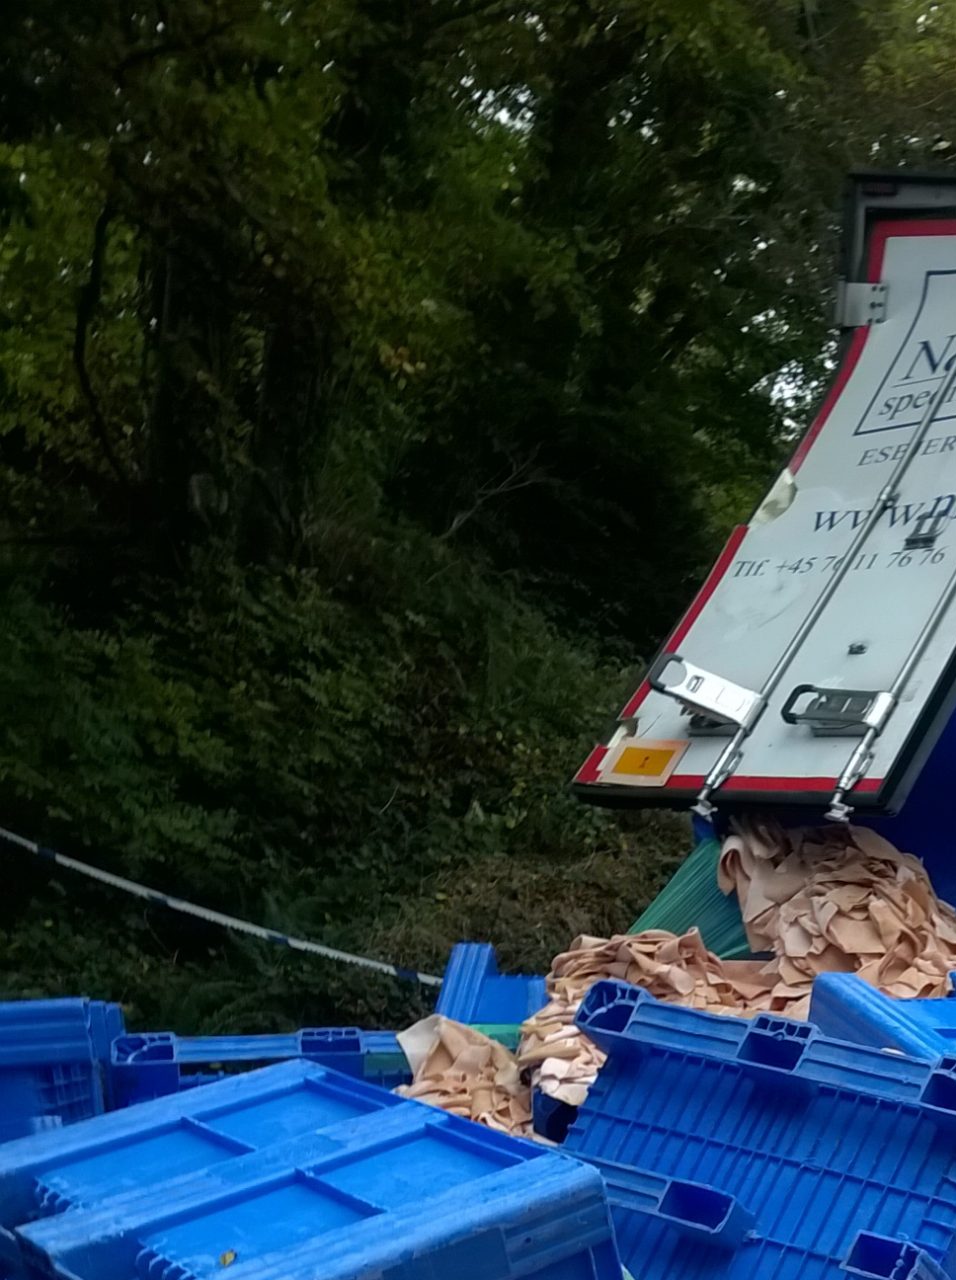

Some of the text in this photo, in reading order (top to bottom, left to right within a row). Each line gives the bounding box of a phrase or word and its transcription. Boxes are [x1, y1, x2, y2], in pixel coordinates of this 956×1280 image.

[733, 559, 770, 577] Tlf.
[775, 556, 818, 574] +45
[853, 552, 879, 570] 11
[886, 549, 915, 568] 76
[919, 545, 949, 566] 76
